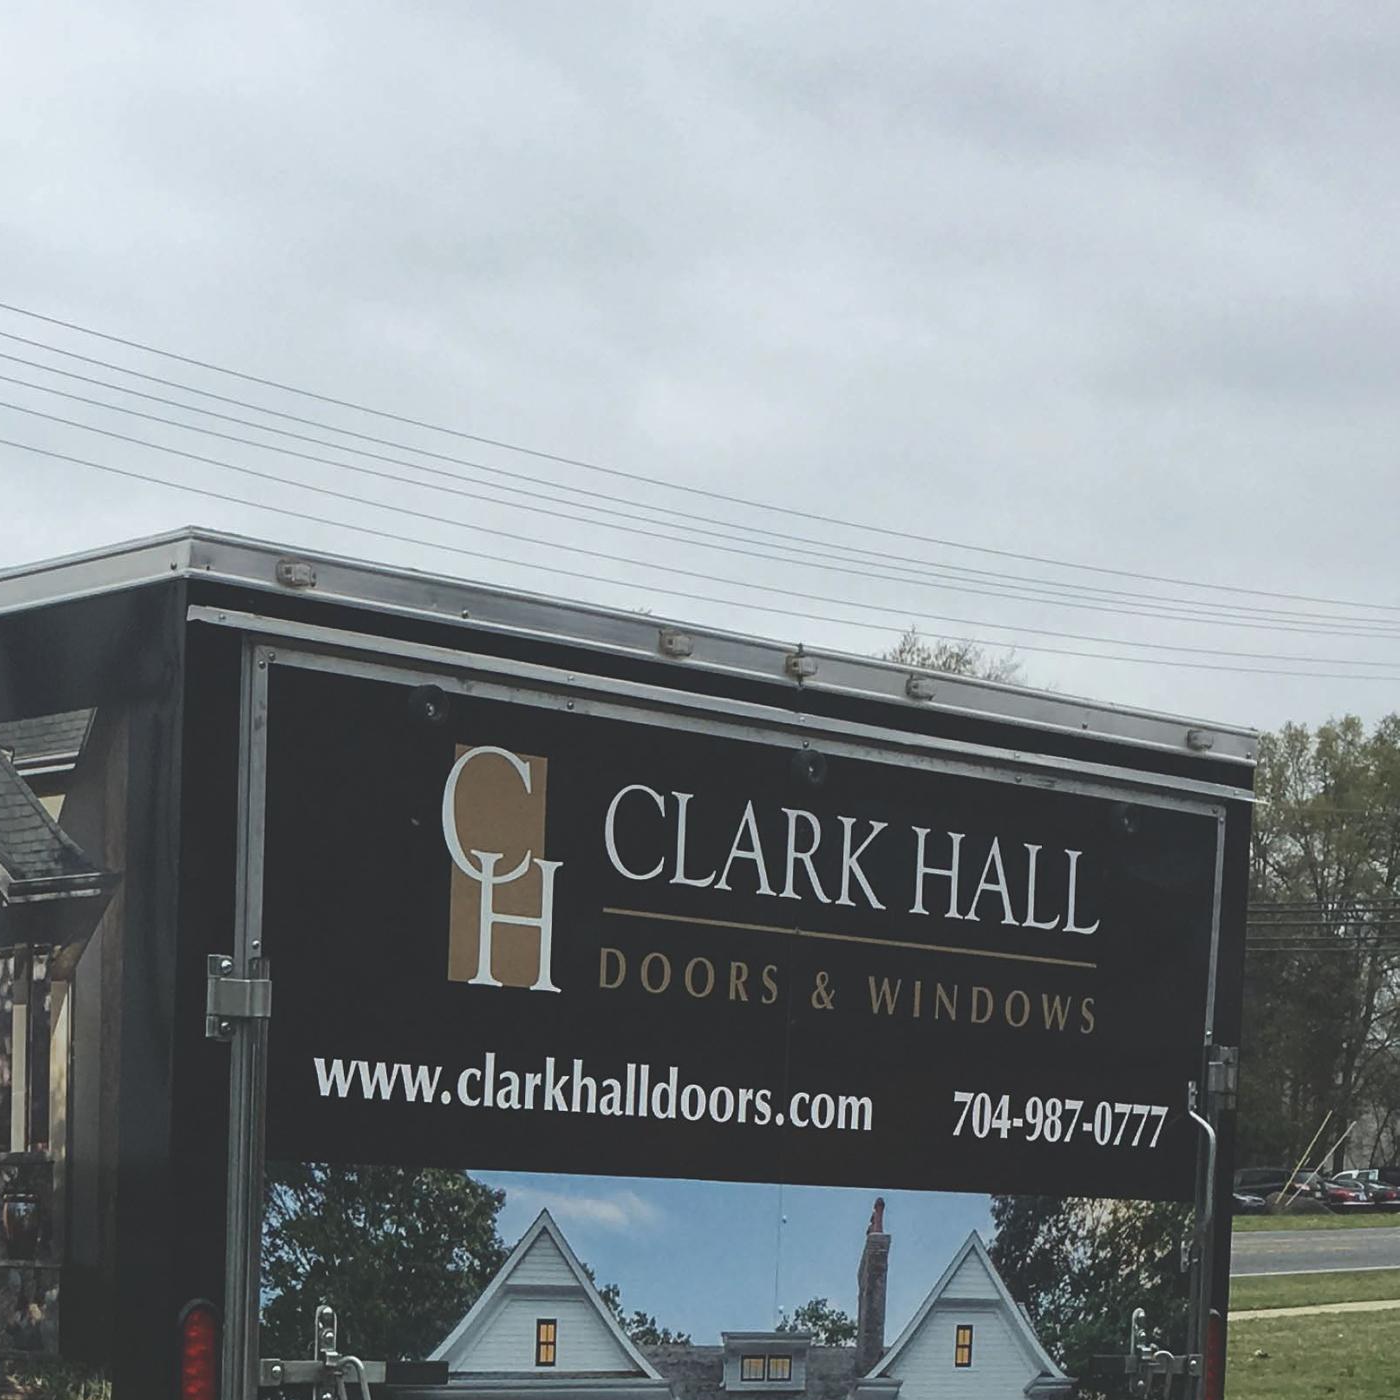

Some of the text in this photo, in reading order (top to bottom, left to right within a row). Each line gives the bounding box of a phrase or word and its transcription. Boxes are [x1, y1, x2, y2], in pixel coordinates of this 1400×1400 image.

[604, 784, 1100, 935] CLARK HALL
[600, 947, 1096, 1034] DOORS & WINDOWS
[313, 1052, 873, 1131] www.clarkhalldoors.com
[953, 1091, 1169, 1148] 704-987-0777
